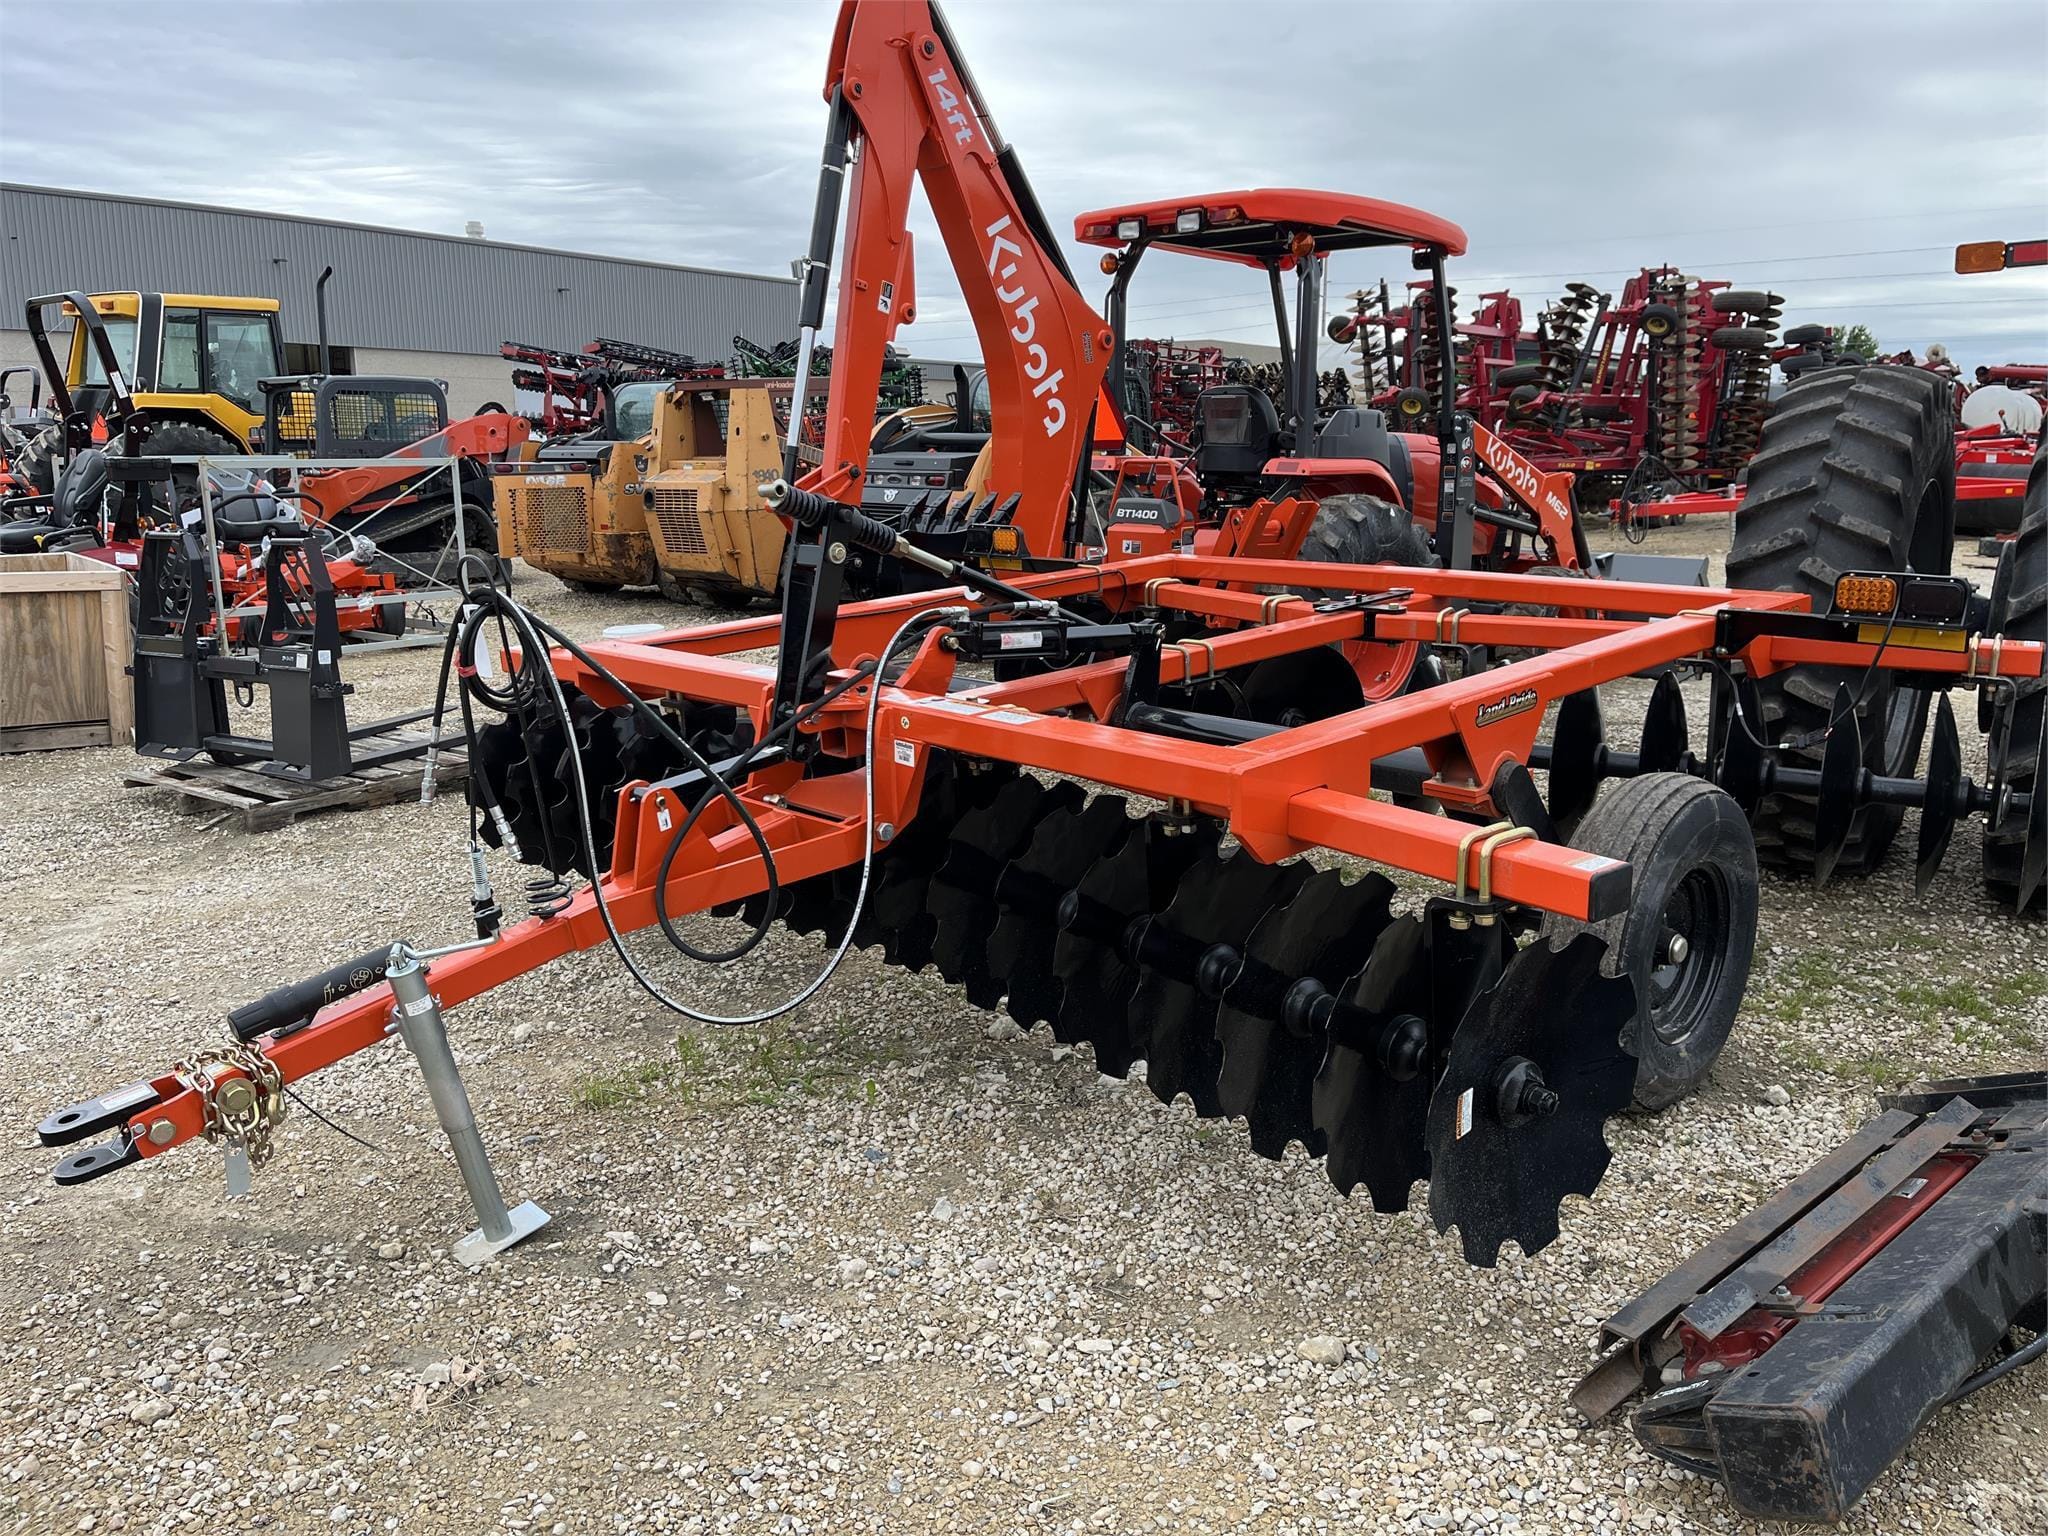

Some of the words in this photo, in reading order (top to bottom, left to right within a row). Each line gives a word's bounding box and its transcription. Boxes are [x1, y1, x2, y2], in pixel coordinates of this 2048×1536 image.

[928, 68, 973, 146] 14ft
[986, 214, 1066, 438] Kubota
[1486, 436, 1538, 498] Kubota
[1116, 508, 1158, 519] BT1400
[1546, 491, 1569, 520] M62
